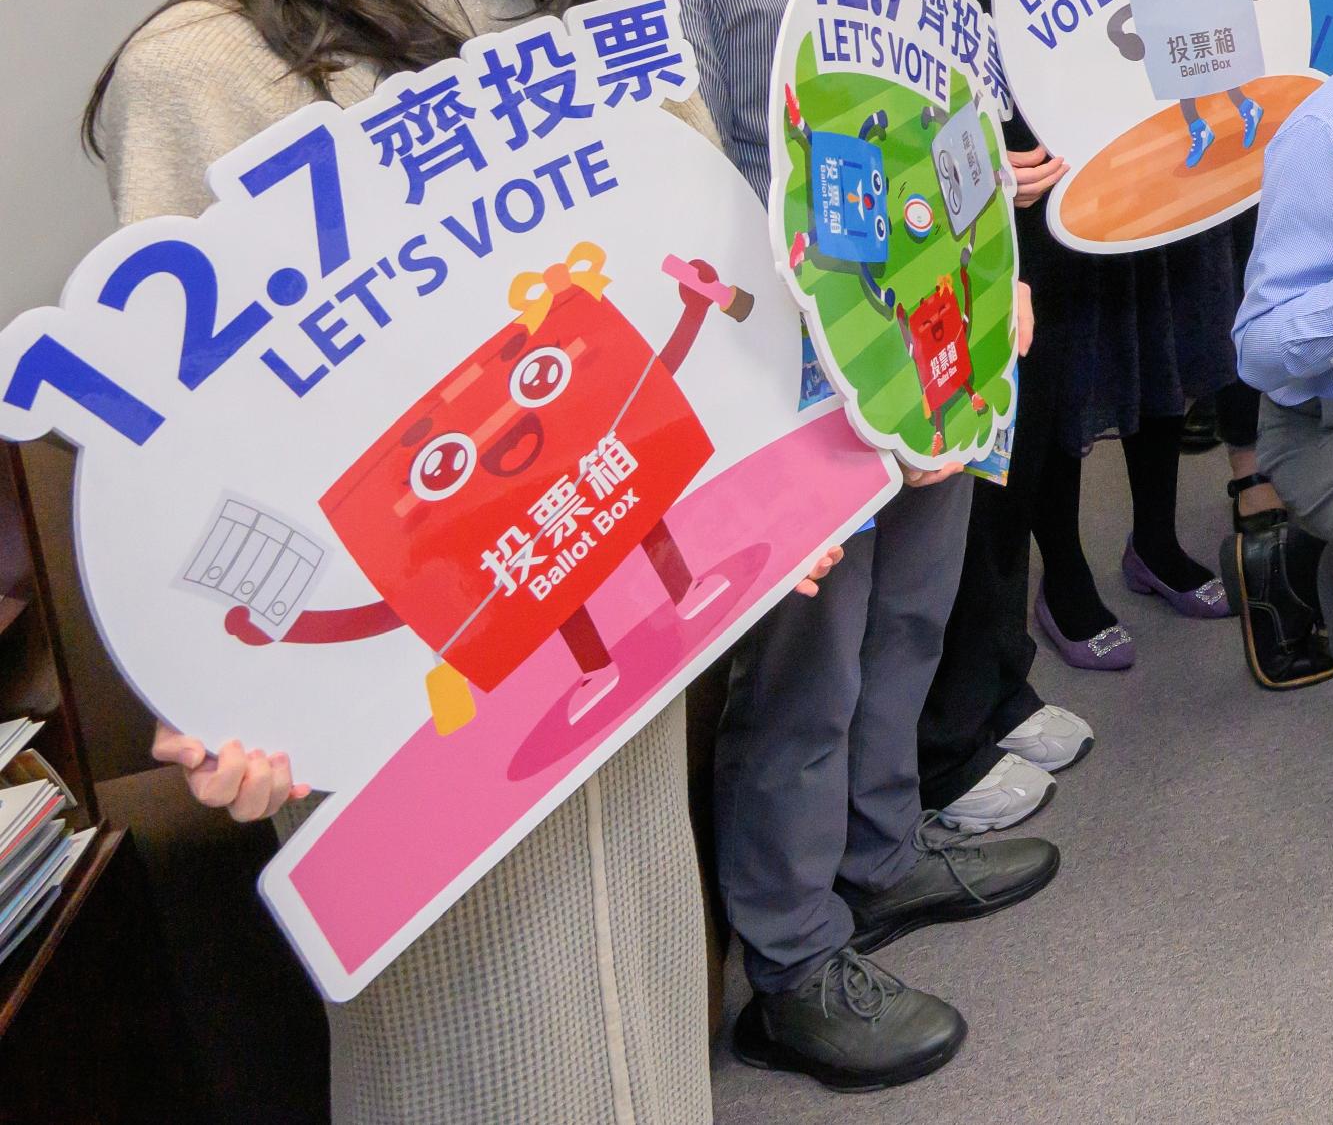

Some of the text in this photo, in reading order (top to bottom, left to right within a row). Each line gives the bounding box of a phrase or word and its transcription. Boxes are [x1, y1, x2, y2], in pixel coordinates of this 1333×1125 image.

[818, 18, 947, 103] LET'S VOTE
[1166, 28, 1236, 65] 投票箱
[1180, 59, 1232, 78] Ballot Box
[4, 0, 682, 446] 12.7 齊投票
[261, 141, 619, 398] LET'S VOTE
[480, 431, 639, 598] 投票箱
[528, 487, 641, 602] Ballot Box
